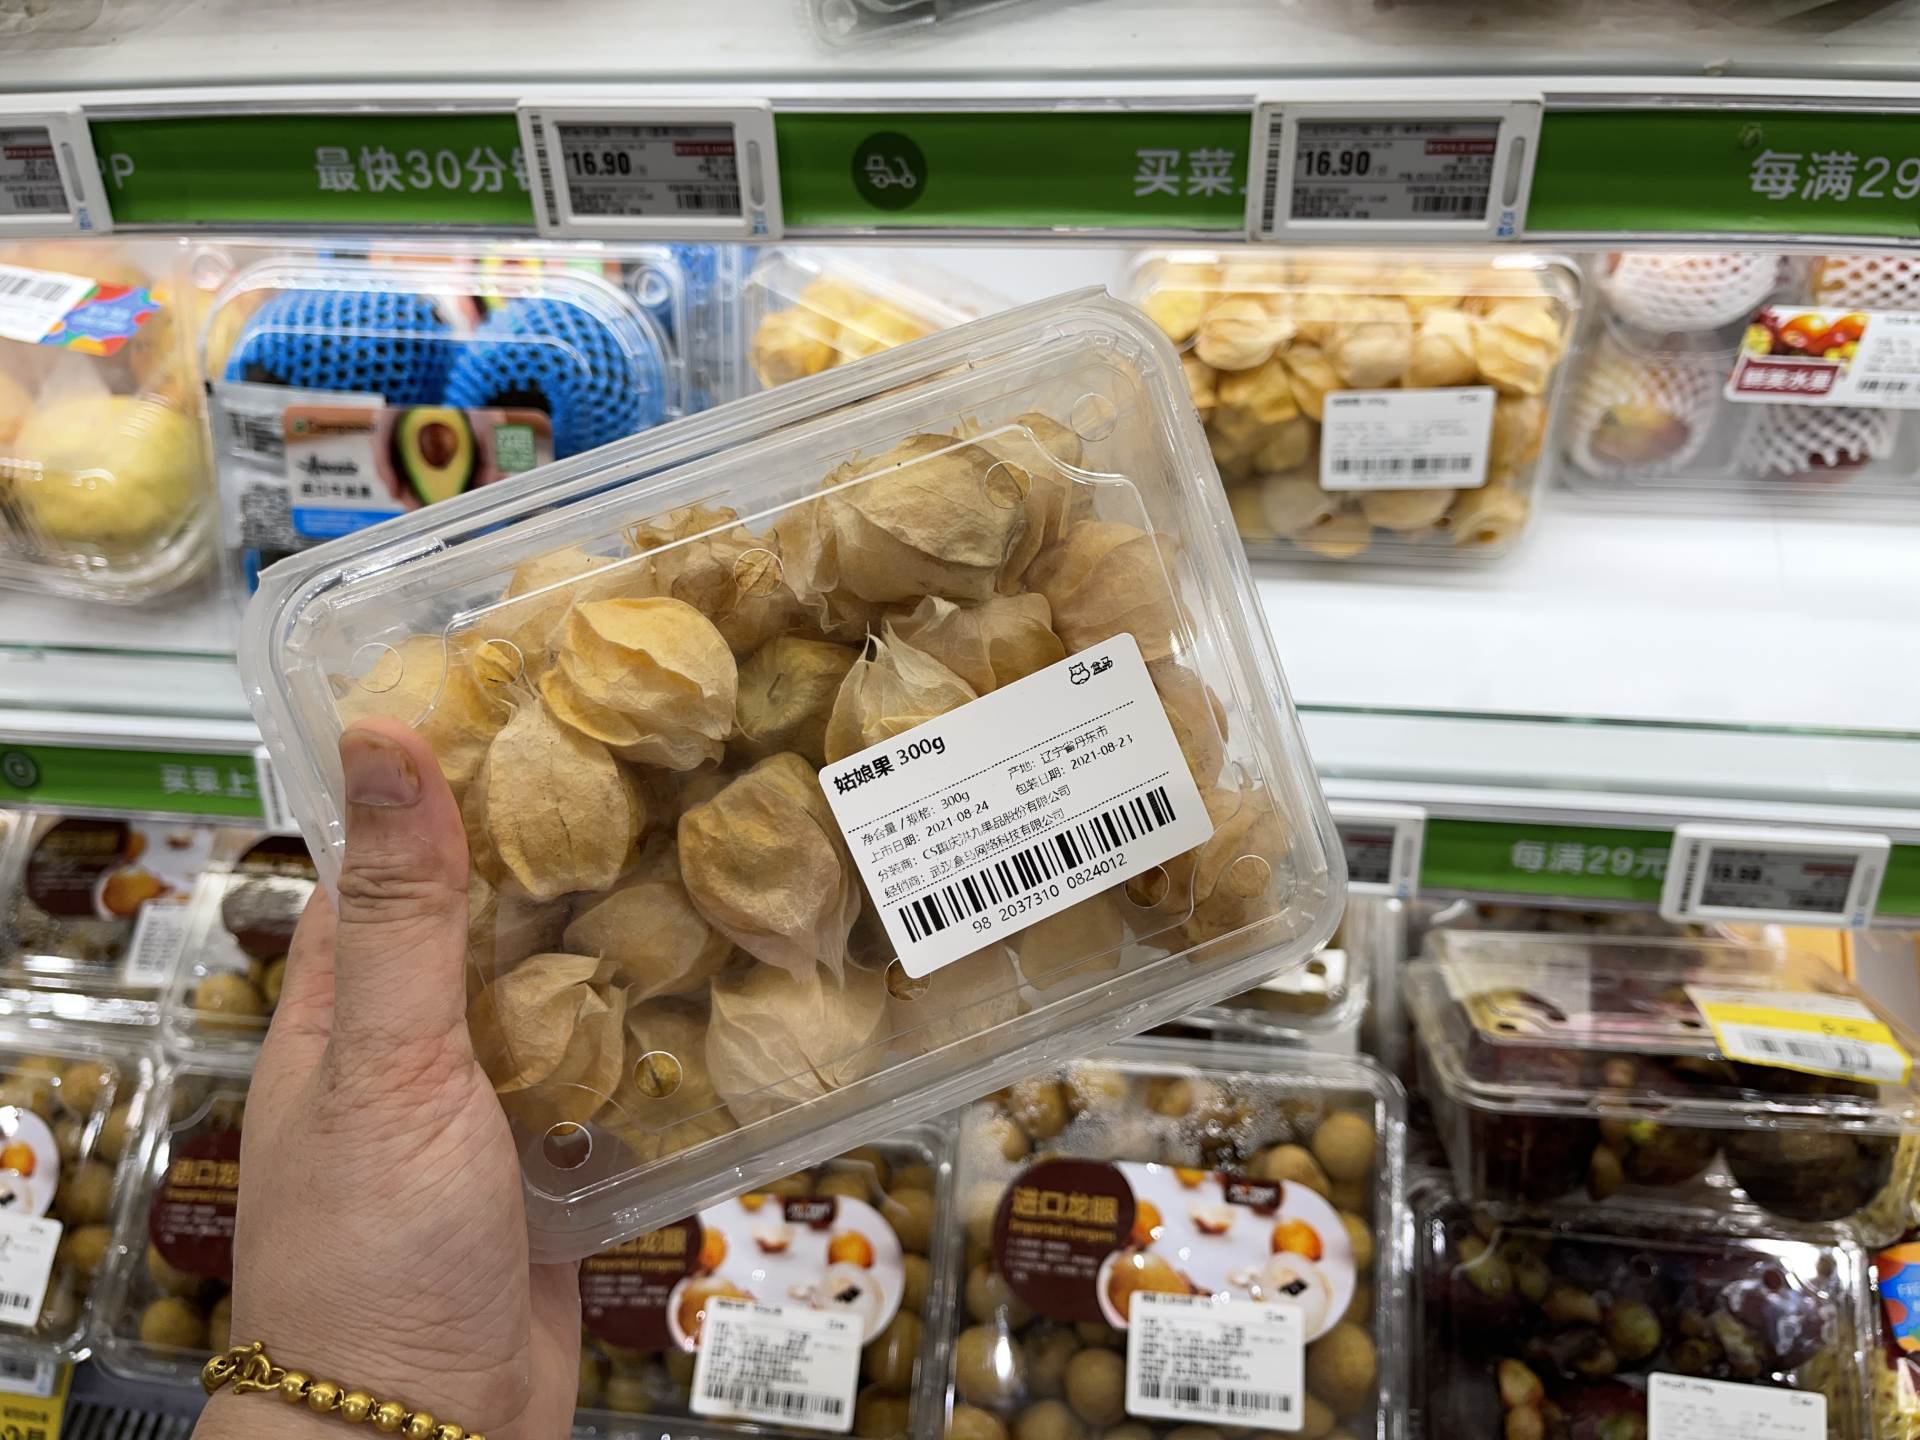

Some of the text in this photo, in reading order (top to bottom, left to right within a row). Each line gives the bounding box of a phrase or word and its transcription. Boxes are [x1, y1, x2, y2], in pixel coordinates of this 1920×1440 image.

[100, 154, 135, 189] P
[1133, 148, 1247, 197] 买菜
[1749, 149, 1920, 201] 每满29
[1090, 656, 1114, 676] 盒马
[833, 736, 946, 795] 姑娘果 300g
[926, 800, 990, 838] 2021-08-24
[940, 791, 970, 810] 300g
[972, 853, 1128, 933] 98 2037310 0824012
